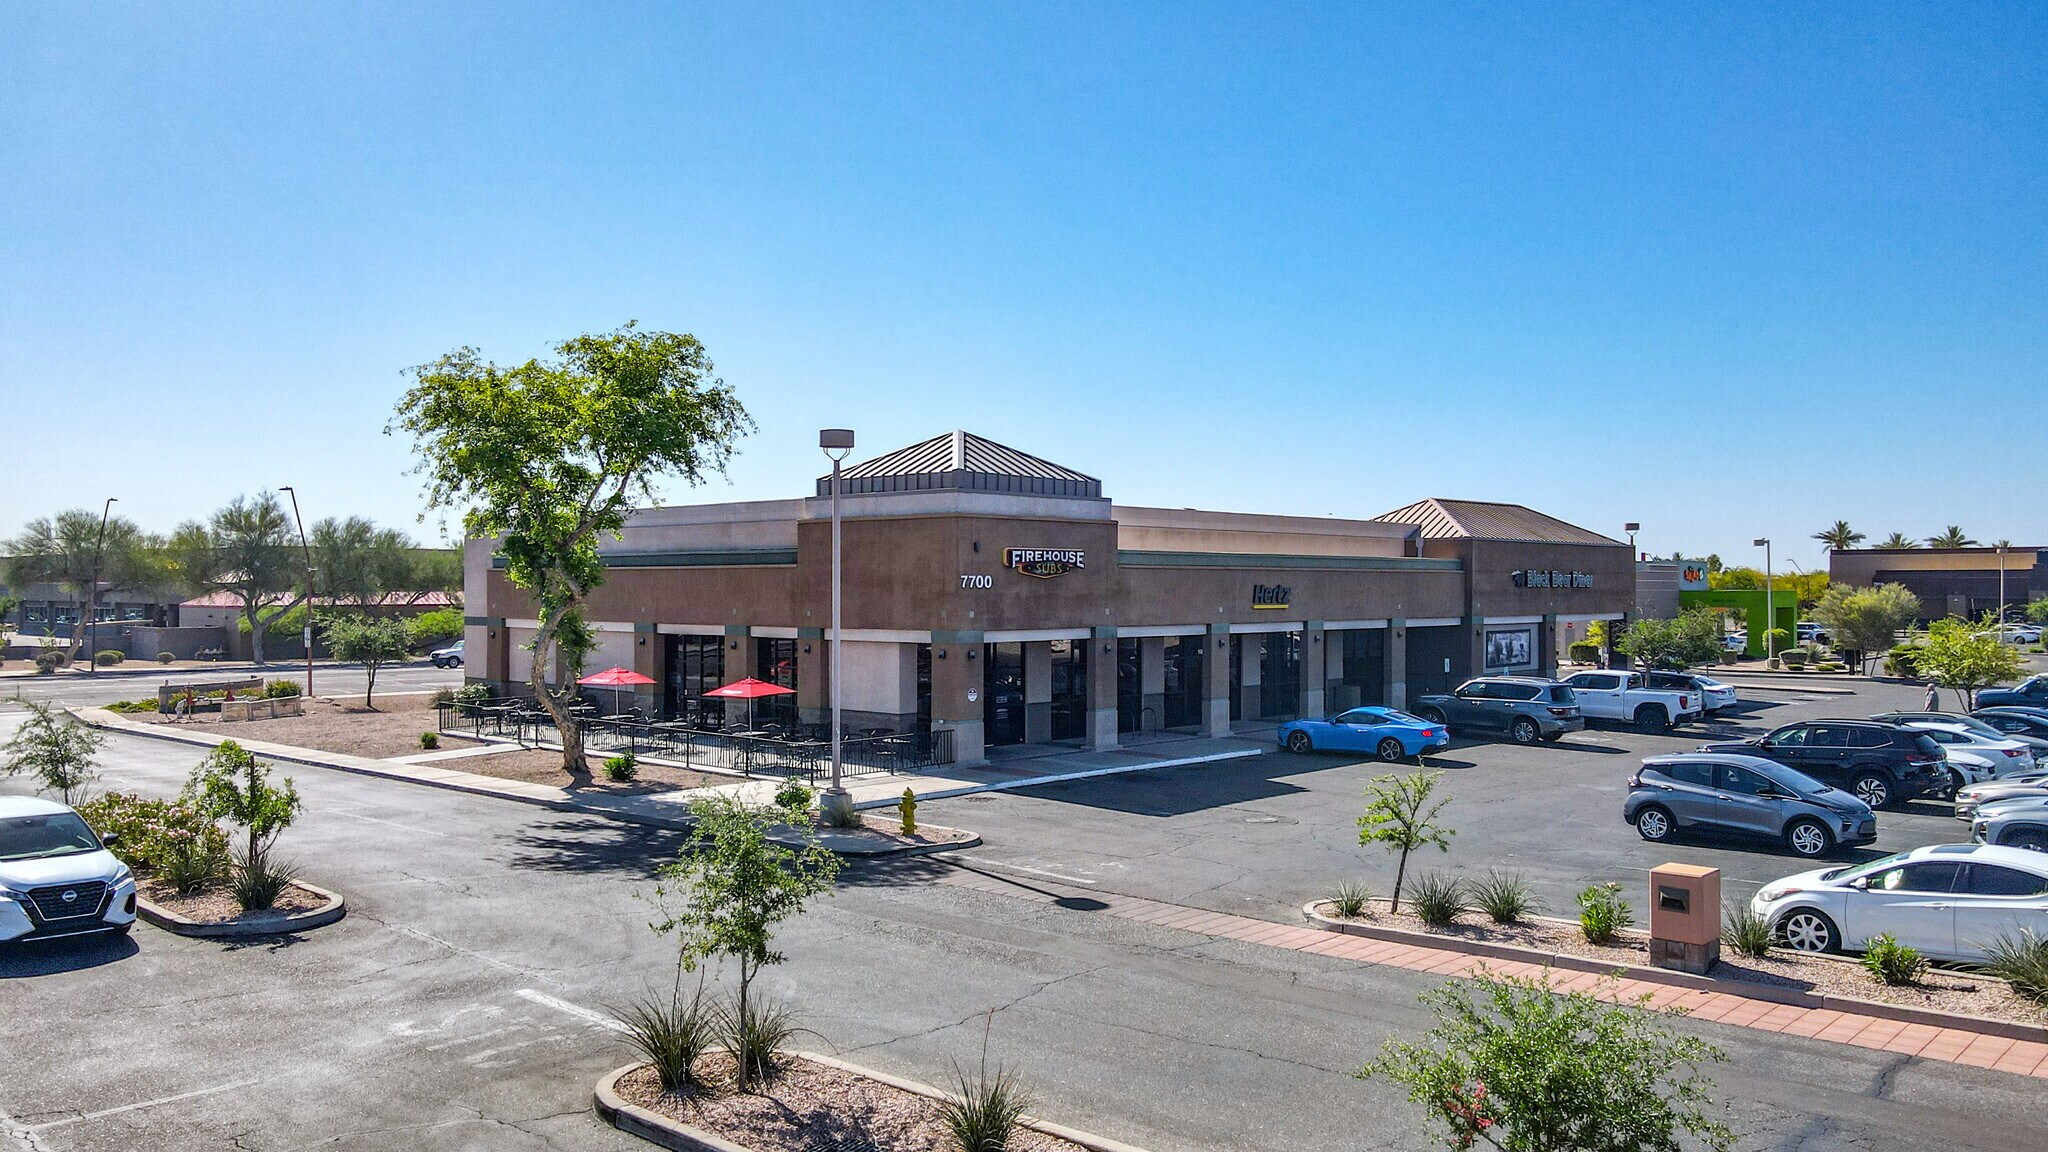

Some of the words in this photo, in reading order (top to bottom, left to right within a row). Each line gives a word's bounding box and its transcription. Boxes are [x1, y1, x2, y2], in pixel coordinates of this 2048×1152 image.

[1012, 550, 1085, 569] FIREHOUSE
[1036, 563, 1062, 574] SUBS
[960, 575, 992, 589] 7700
[1253, 584, 1291, 603] Hertz
